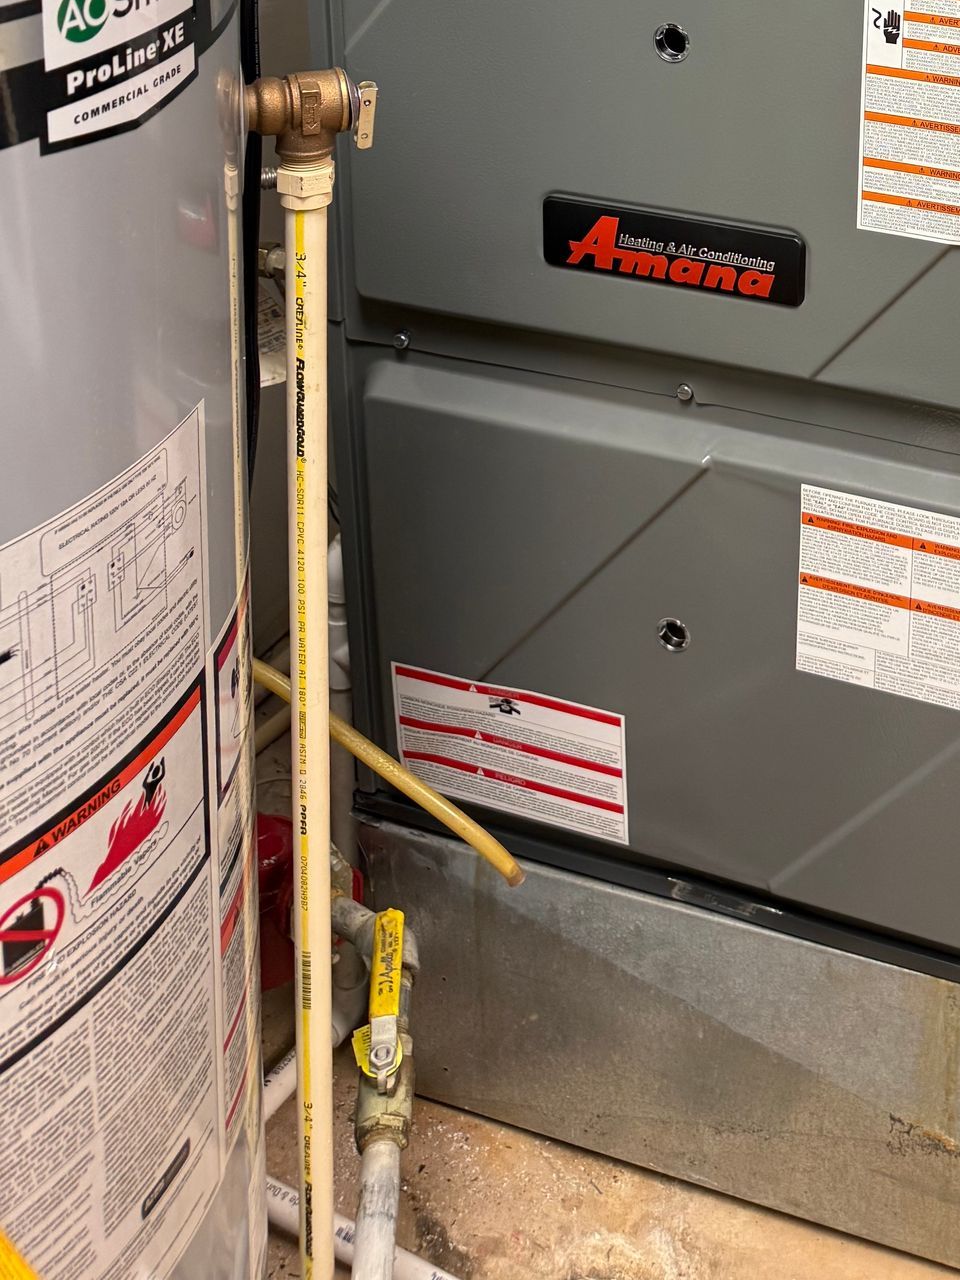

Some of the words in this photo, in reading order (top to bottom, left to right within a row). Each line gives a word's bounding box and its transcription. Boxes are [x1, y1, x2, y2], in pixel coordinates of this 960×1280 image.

[67, 41, 157, 96] ProLine
[162, 21, 185, 52] XE
[74, 85, 149, 125] COMMERCIAL
[153, 65, 181, 88] GRADE
[566, 216, 775, 297] Amana
[618, 233, 664, 252] Heating
[666, 241, 676, 253] &
[678, 243, 697, 257] Air
[699, 247, 776, 271] Conditioning
[296, 470, 305, 515] HC-SDR11
[297, 521, 305, 544] CPVC
[297, 549, 305, 572] 4120
[297, 578, 305, 594] 100
[297, 599, 306, 614] PSI
[298, 638, 306, 665] WATER
[298, 669, 306, 681] AT
[493, 737, 522, 750] DANGER
[495, 773, 526, 786] PELIGRO
[51, 778, 122, 842] WARNING
[90, 866, 132, 908] Flammable
[134, 839, 157, 865] Vapors
